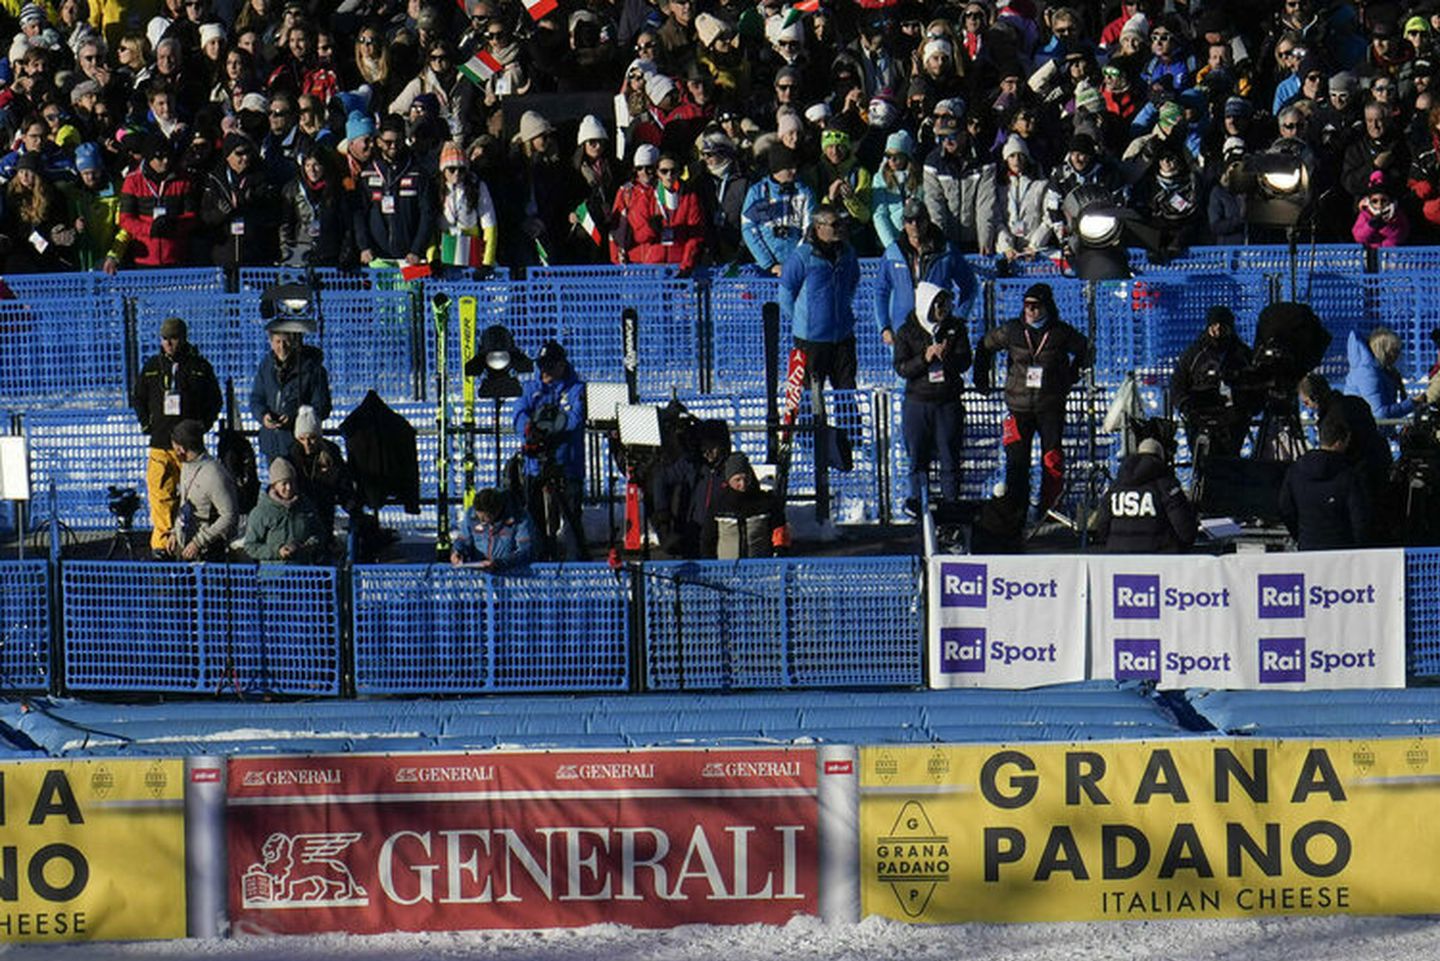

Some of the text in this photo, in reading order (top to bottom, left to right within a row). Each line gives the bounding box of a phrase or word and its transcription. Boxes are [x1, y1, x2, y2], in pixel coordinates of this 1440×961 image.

[1111, 491, 1156, 517] USA
[945, 574, 1057, 602] Rai Sport
[1117, 585, 1230, 610] Rai Sport
[1262, 584, 1375, 608] Rai Sport
[944, 638, 1056, 665] Rai Sport
[1119, 649, 1231, 675] Rai Sport
[1262, 648, 1376, 673] Rai Sport
[265, 770, 341, 785] GENERALI
[417, 765, 494, 781] GENERALI
[579, 764, 654, 779] GENERALI
[725, 761, 800, 776] GENERALI
[979, 747, 1347, 809] GRANA
[907, 818, 919, 830] G
[877, 845, 949, 858] GRANA
[983, 821, 1352, 882] PADANO
[378, 826, 805, 905] GENERALI
[877, 860, 950, 873] PADANO
[910, 890, 919, 901] P
[1102, 887, 1351, 913] ITALIAN CHEESE
